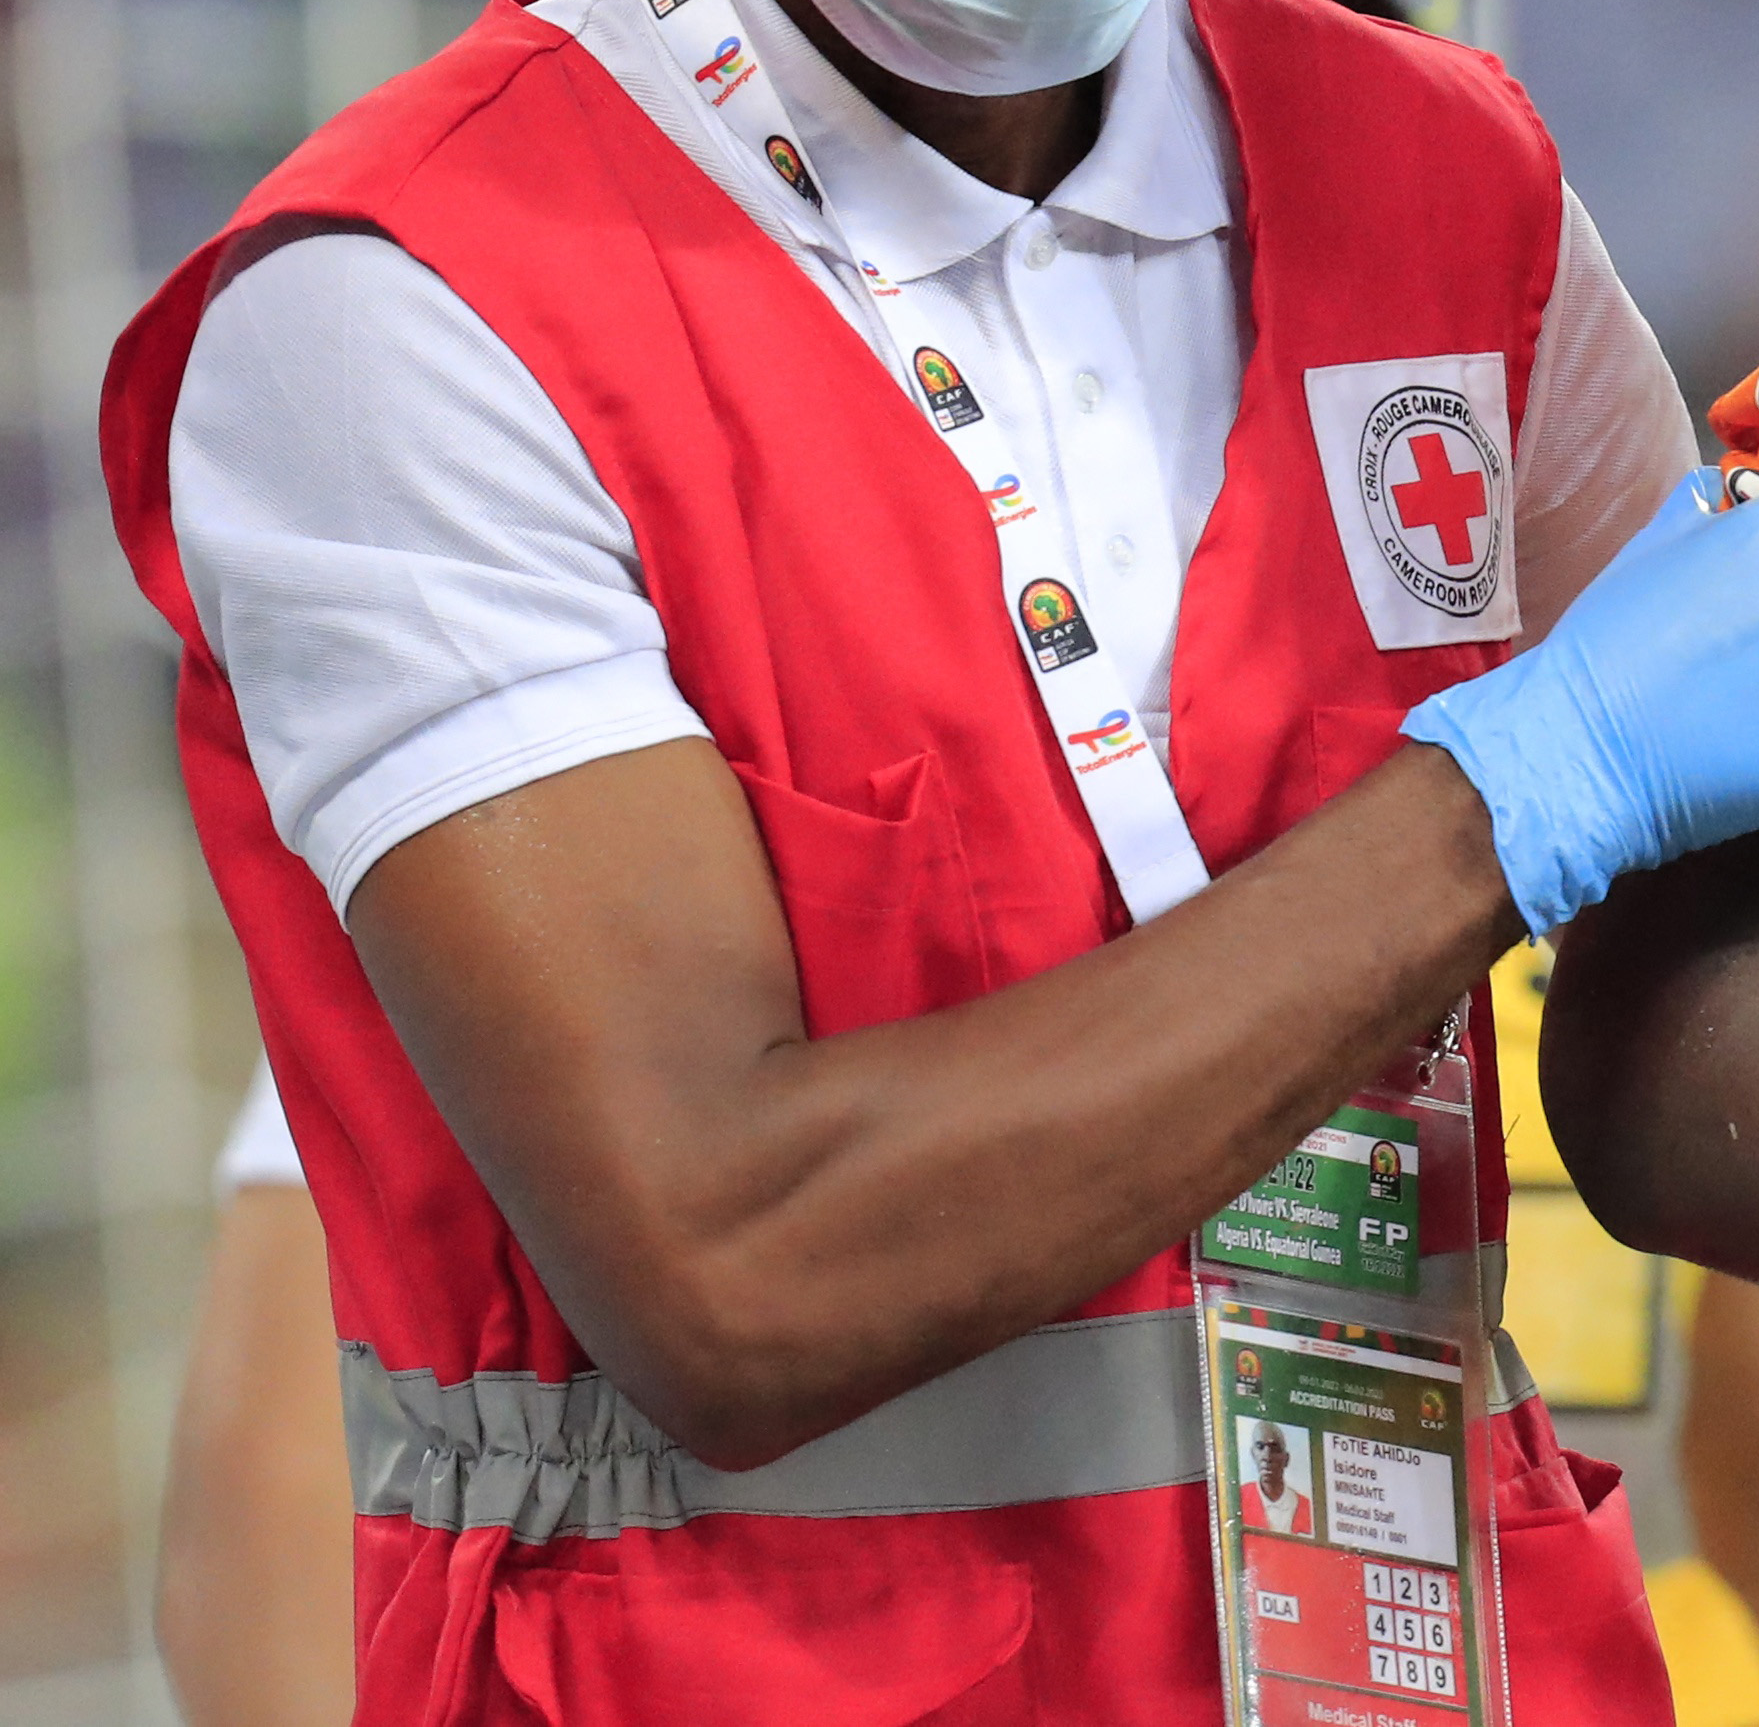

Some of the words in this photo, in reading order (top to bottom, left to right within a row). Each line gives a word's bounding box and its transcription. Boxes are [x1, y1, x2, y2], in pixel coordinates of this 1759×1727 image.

[936, 390, 963, 406] CAF
[1364, 448, 1379, 502] CROIX
[1372, 395, 1411, 441] ROUGE
[1383, 537, 1466, 608] CAMEROON
[1469, 576, 1489, 606] RED
[1040, 623, 1075, 643] CAF
[1076, 741, 1147, 774] TotalEnergies
[1216, 1221, 1249, 1251] Algeria
[1265, 1230, 1310, 1260] Equatorial
[1311, 1239, 1342, 1265] Guinea
[1290, 1390, 1367, 1416] ACCREDITATION
[1369, 1405, 1396, 1423] PASS
[1332, 1436, 1368, 1456] FoTIE
[1373, 1444, 1421, 1466] AHIDJo
[1334, 1459, 1377, 1480] Isidore
[1336, 1501, 1371, 1520] Medical
[1373, 1509, 1395, 1524] Staff
[1373, 1573, 1381, 1594] 1
[1400, 1577, 1412, 1600] 2
[1430, 1582, 1441, 1605] 3
[1262, 1596, 1293, 1618] DLA
[1375, 1613, 1386, 1636] 4
[1403, 1619, 1414, 1642] 5
[1432, 1624, 1444, 1647] 6
[1377, 1654, 1388, 1677] 7
[1407, 1660, 1418, 1683] 8
[1435, 1665, 1446, 1688] 9
[1307, 1700, 1372, 1727] Medical
